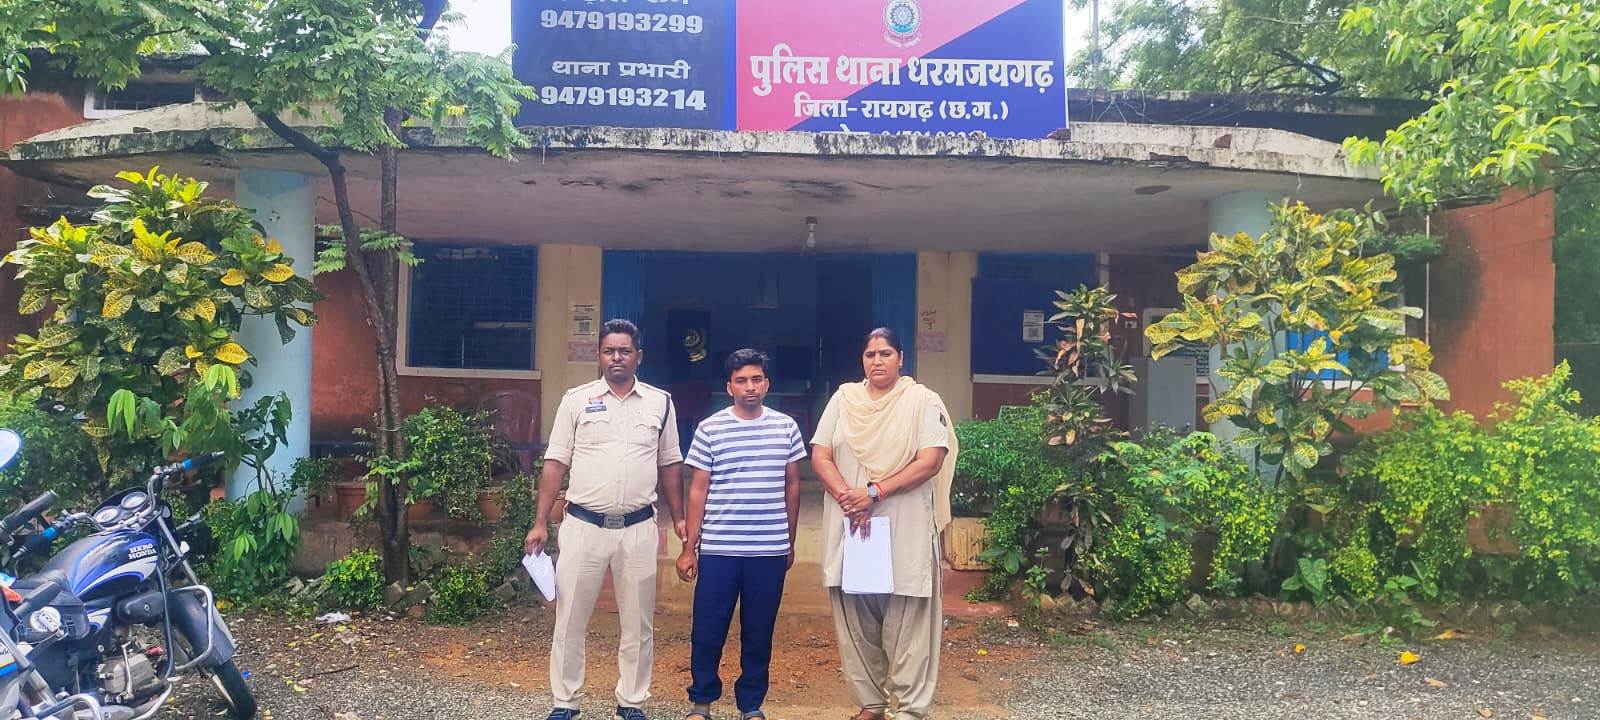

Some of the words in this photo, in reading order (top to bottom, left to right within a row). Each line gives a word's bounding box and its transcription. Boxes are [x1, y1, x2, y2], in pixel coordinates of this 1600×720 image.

[540, 10, 703, 33] 9479193299
[551, 60, 610, 76] थाना
[618, 60, 691, 79] प्रभारी
[749, 43, 829, 96] पुलिस
[835, 55, 902, 85] थाना
[907, 57, 1054, 94] धरमजयगढ़
[541, 86, 706, 110] 9479193214
[128, 549, 157, 559] HONDA
[129, 543, 153, 553] HERO
